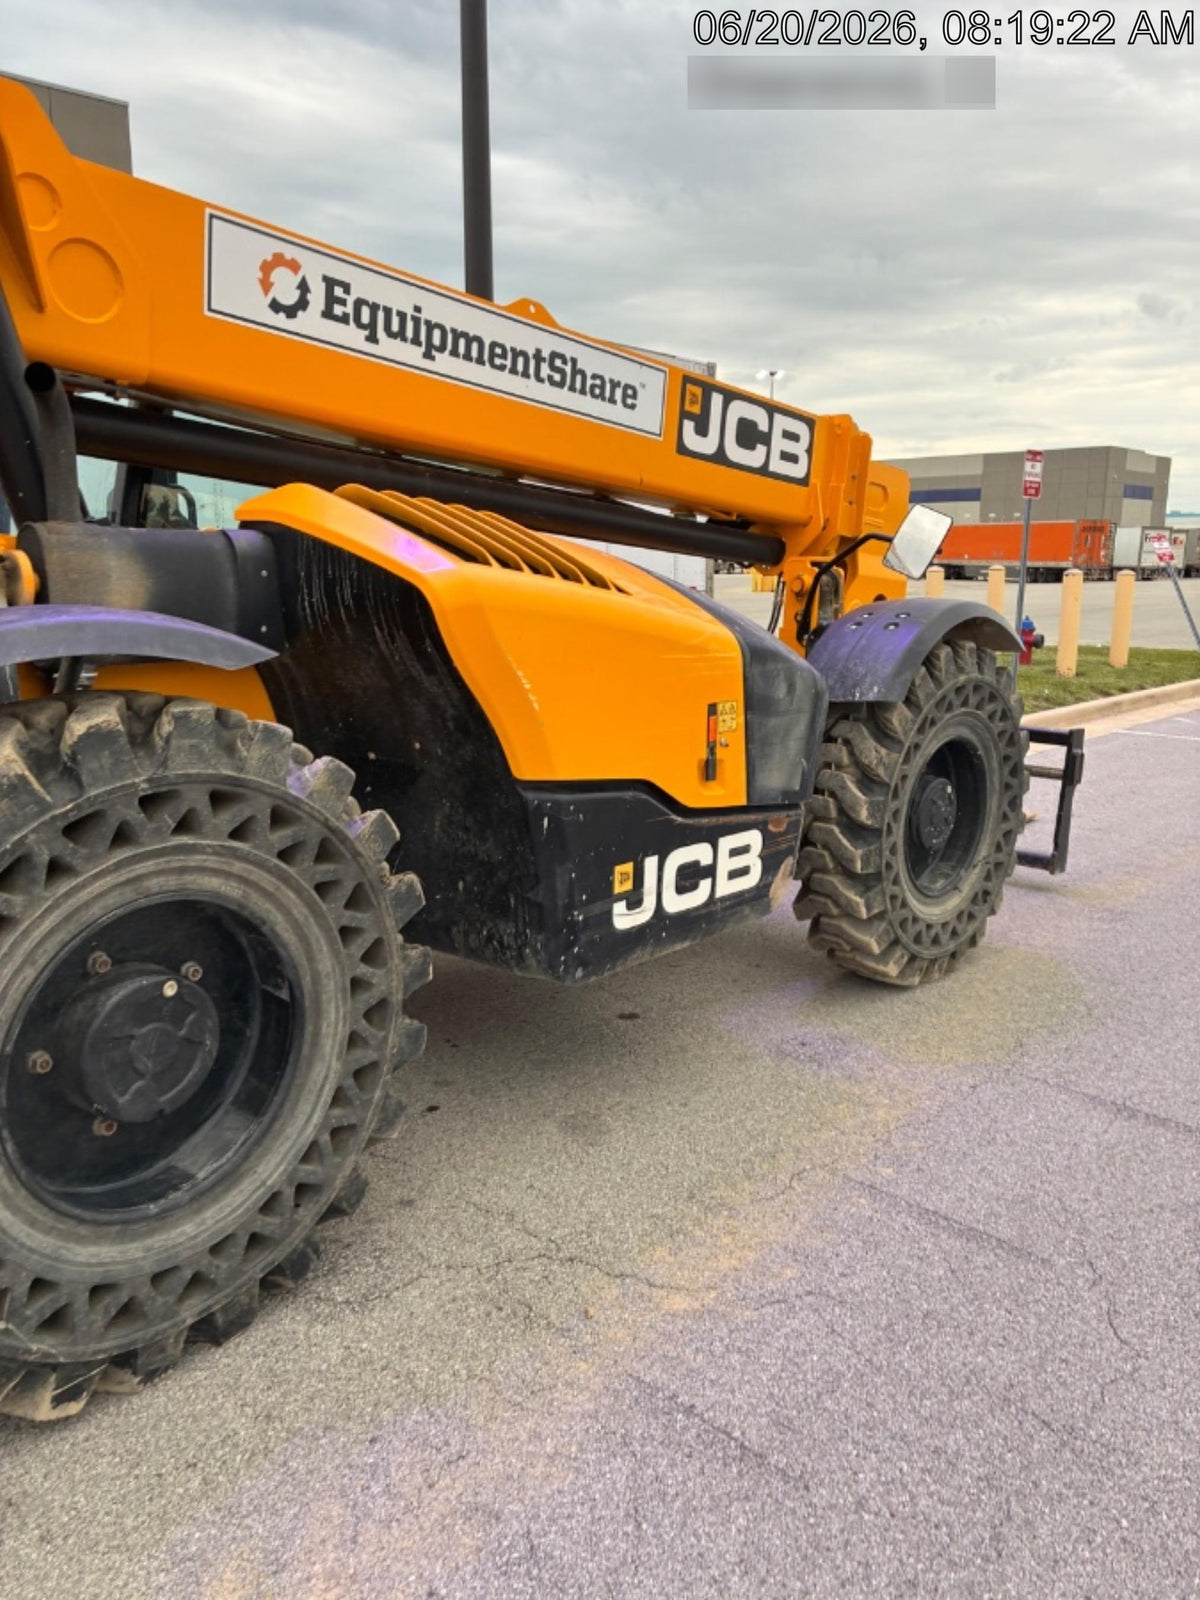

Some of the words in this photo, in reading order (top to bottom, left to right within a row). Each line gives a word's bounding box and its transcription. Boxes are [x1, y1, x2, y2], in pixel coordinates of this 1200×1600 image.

[321, 274, 639, 411] EquipmentShare
[682, 391, 811, 479] JCB
[612, 829, 764, 930] JCB
